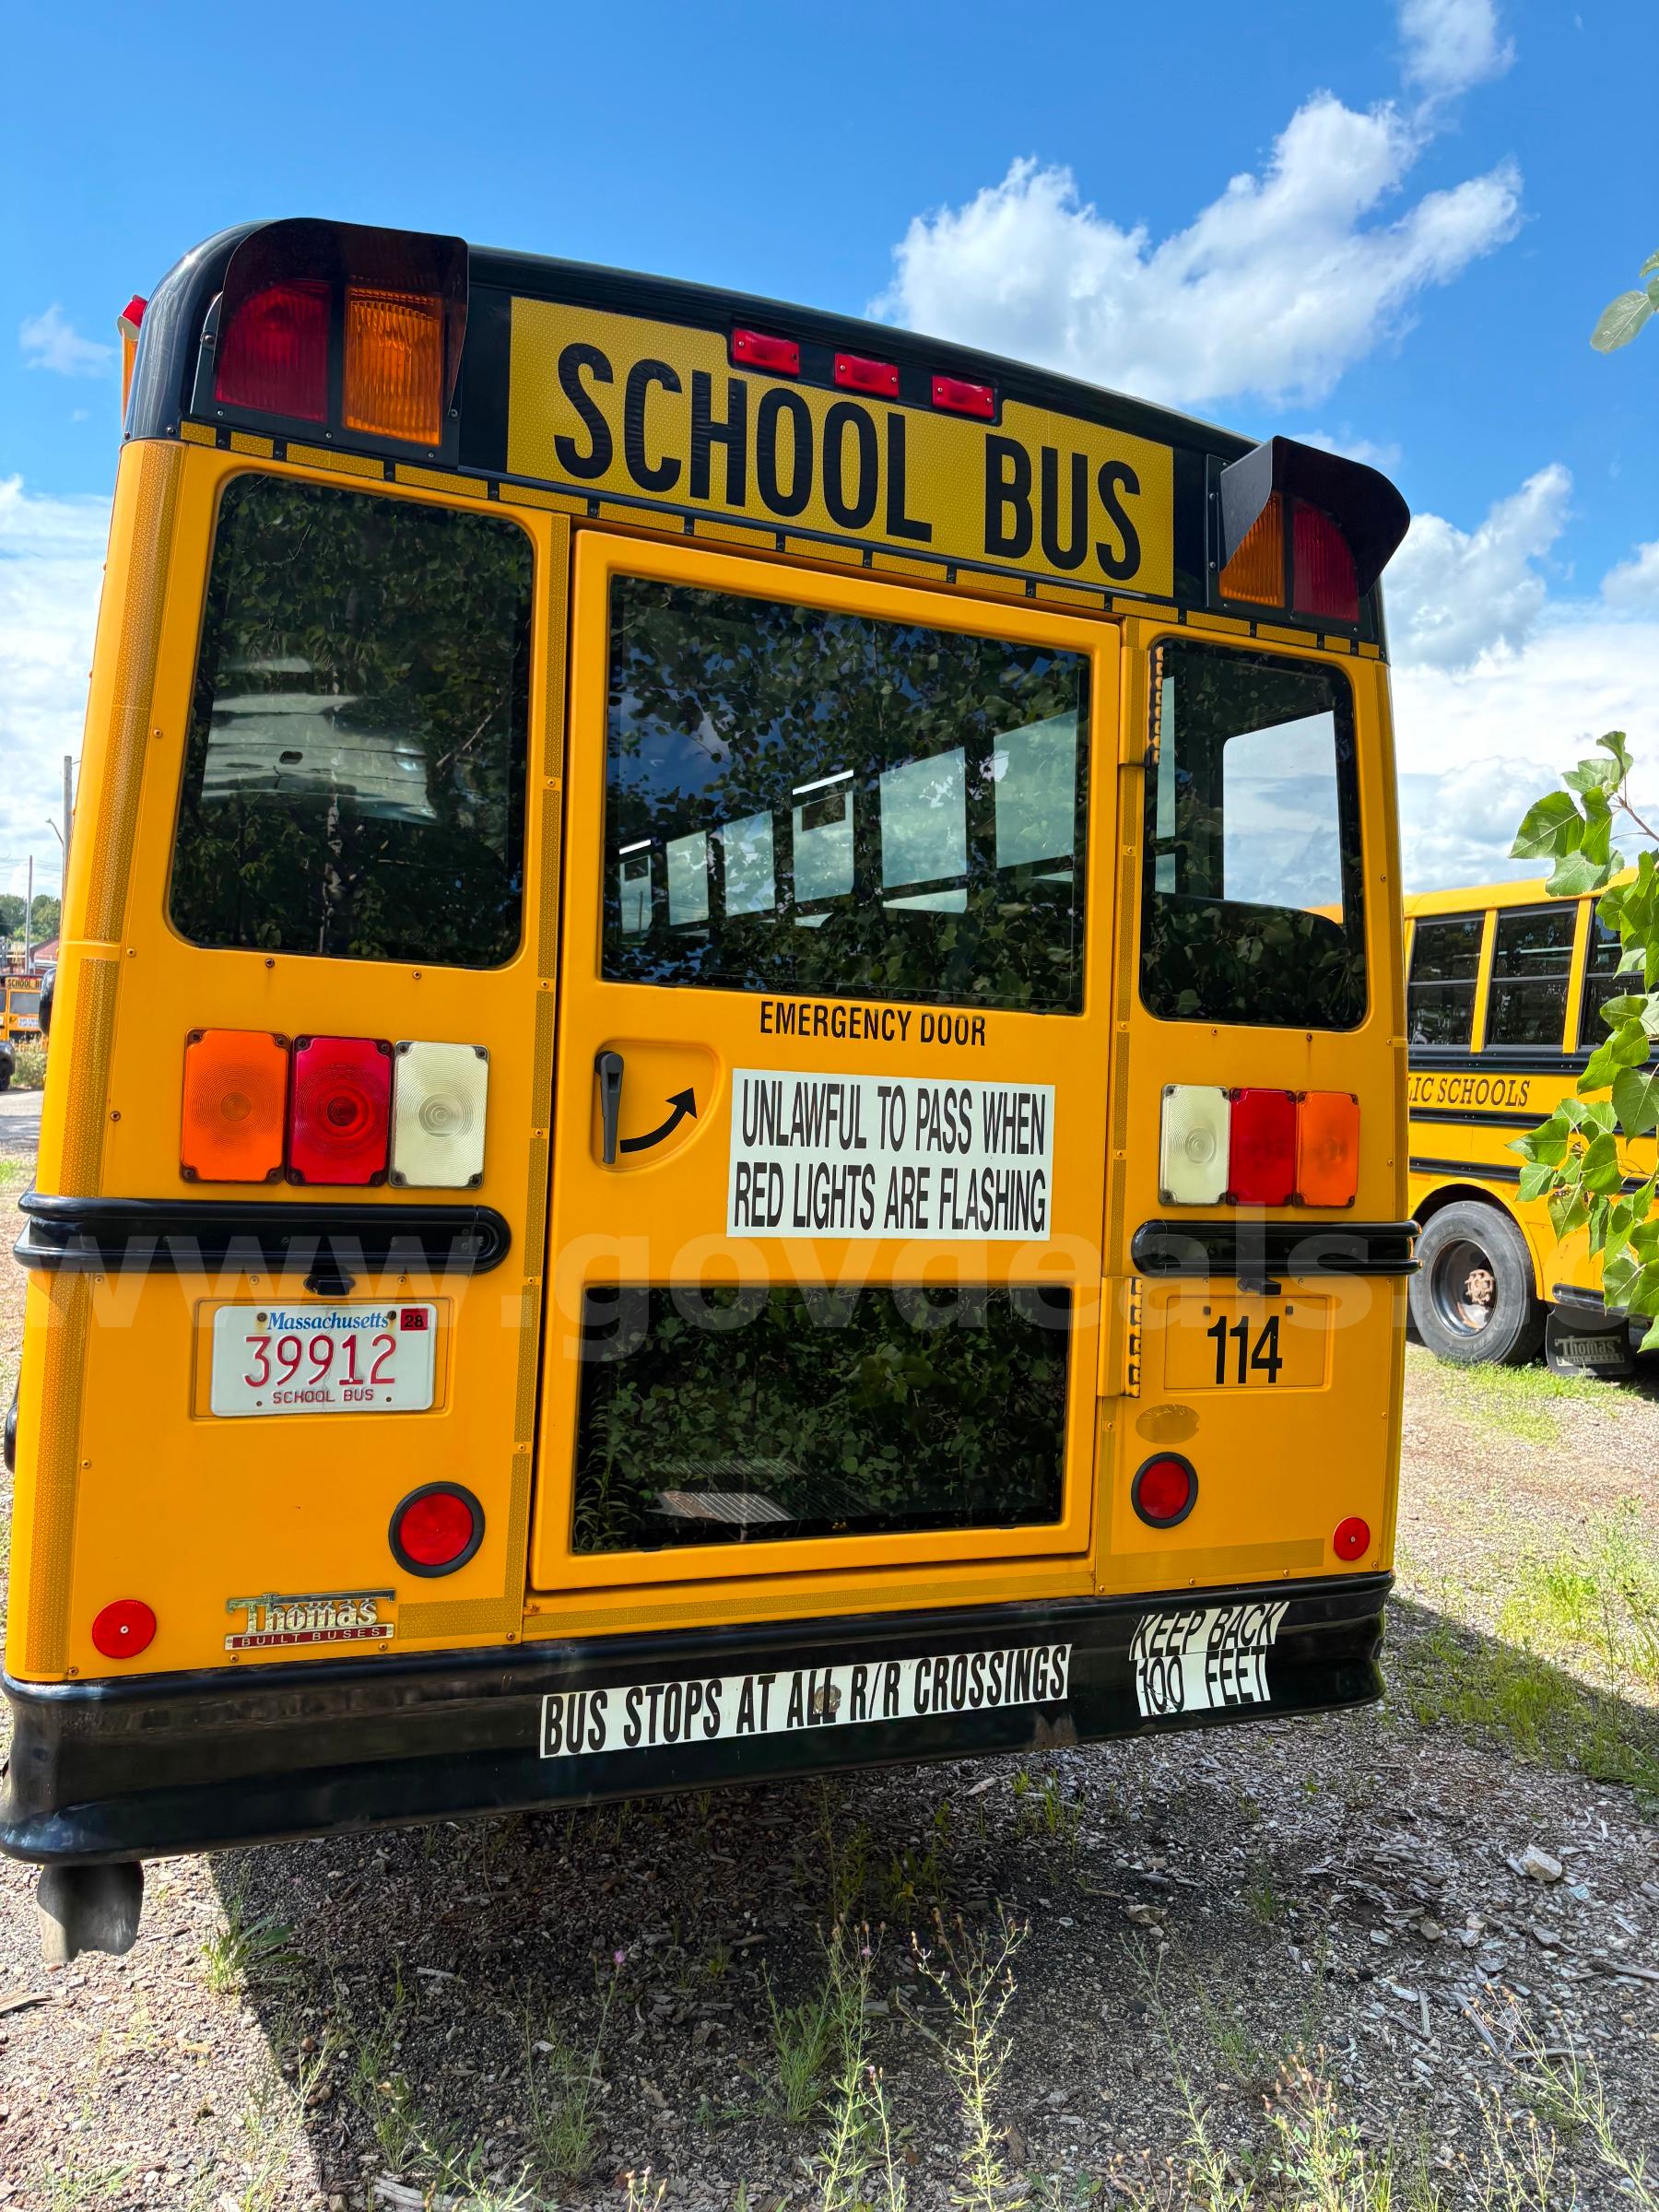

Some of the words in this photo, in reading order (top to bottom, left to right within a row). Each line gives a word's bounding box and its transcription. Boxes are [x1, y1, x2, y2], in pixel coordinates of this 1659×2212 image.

[554, 342, 932, 544] SCHOOL
[983, 433, 1142, 581] BUS
[759, 1001, 912, 1041] EMERGENCY
[920, 1012, 986, 1046] DOOR
[742, 1078, 867, 1150] UNLAWFUL
[877, 1085, 906, 1152] TO
[915, 1087, 972, 1155] PASS
[982, 1090, 1046, 1156] WHEN
[1437, 1077, 1530, 1107] SCHOOLS
[735, 1161, 783, 1229] RED
[793, 1162, 876, 1230] LIGHTS
[883, 1166, 931, 1230] ARE
[938, 1166, 1046, 1233] FLASHING
[266, 1312, 389, 1331] Massachusetts
[403, 1314, 424, 1328] 28
[1554, 1335, 1622, 1356] Thomas
[243, 1333, 397, 1387] 39912
[1206, 1315, 1283, 1384] 114
[273, 1390, 335, 1405] SCHOOL
[343, 1388, 374, 1402] BUS
[226, 1588, 395, 1635] Thomas
[1130, 1609, 1207, 1660] KEEP
[1206, 1602, 1287, 1652] BACK
[241, 1634, 300, 1647] BUILT
[312, 1628, 381, 1641] BUSES
[544, 1689, 608, 1757] BUS
[623, 1677, 723, 1747] STOPS
[736, 1674, 776, 1735] AT
[786, 1669, 837, 1729] ALL
[850, 1662, 901, 1722] R/R
[913, 1644, 1067, 1715] CROSSINGS
[1138, 1655, 1185, 1715] 100
[1206, 1644, 1266, 1708] FEET
